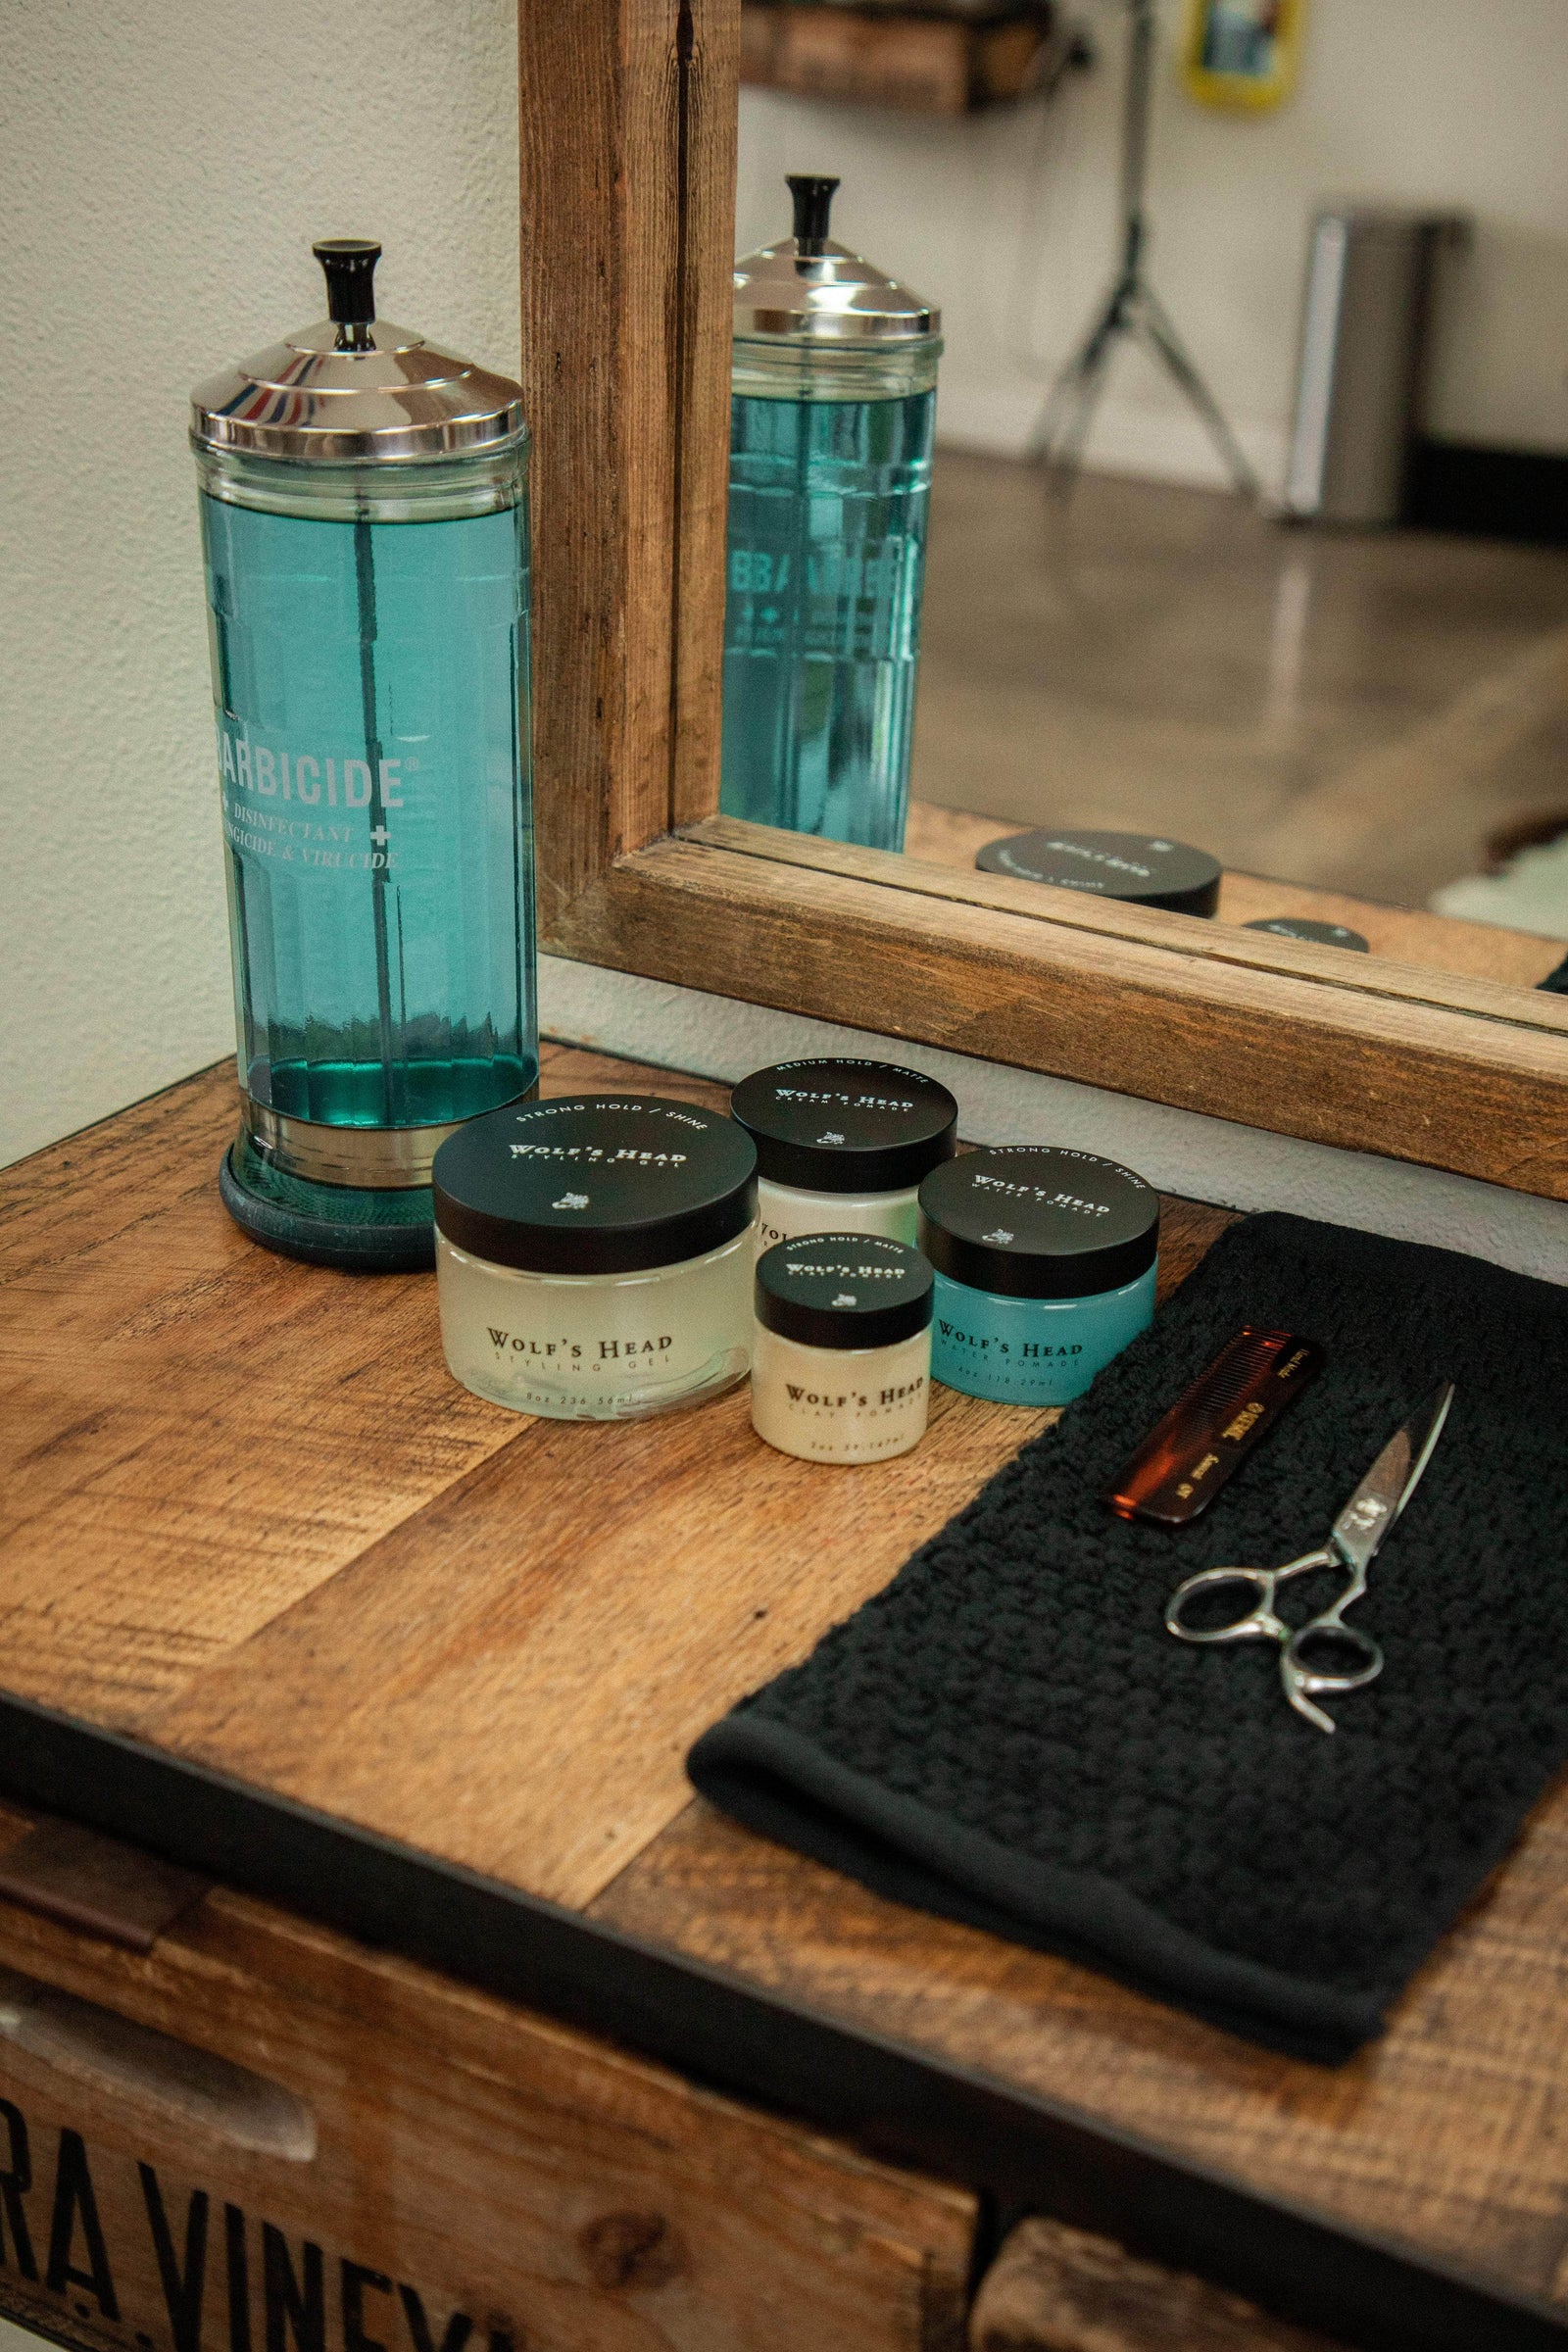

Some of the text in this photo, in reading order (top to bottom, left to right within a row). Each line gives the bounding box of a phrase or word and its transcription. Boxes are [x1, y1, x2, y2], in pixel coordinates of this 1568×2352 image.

[233, 803, 356, 843] DISINFECTANT
[224, 819, 277, 856] NGICIDE
[281, 846, 295, 860] &
[775, 1058, 828, 1072] MEDIUM
[836, 1058, 873, 1067] HOLD
[892, 1066, 929, 1084] MATTE
[774, 1088, 914, 1108] WOLF'S HEAD
[775, 1095, 909, 1112] CREAM POMADE
[515, 1103, 586, 1123] STRONG
[595, 1102, 643, 1112] HOLD
[665, 1110, 709, 1131] SHINE
[509, 1144, 688, 1163] WOLF'S HEAD
[511, 1153, 680, 1168] STYLING GEL
[988, 1146, 1052, 1155] STRONG
[1059, 1149, 1099, 1163] HOLD
[1115, 1166, 1147, 1190] SHINE
[971, 1182, 1103, 1218] WATER POMADE
[974, 1174, 1111, 1213] WOLF'S HEAD
[786, 1237, 825, 1251] STRONG
[873, 1240, 905, 1254] MATTE
[785, 1263, 906, 1275] WOLF'S HEAD
[486, 1326, 673, 1359] WOLF'S HEAD
[938, 1318, 1084, 1358] WOLF'S HEAD
[494, 1351, 671, 1372] STYLING GEL
[941, 1338, 1080, 1369] WATER POMADE
[785, 1376, 924, 1407] WOLF'S HEAD
